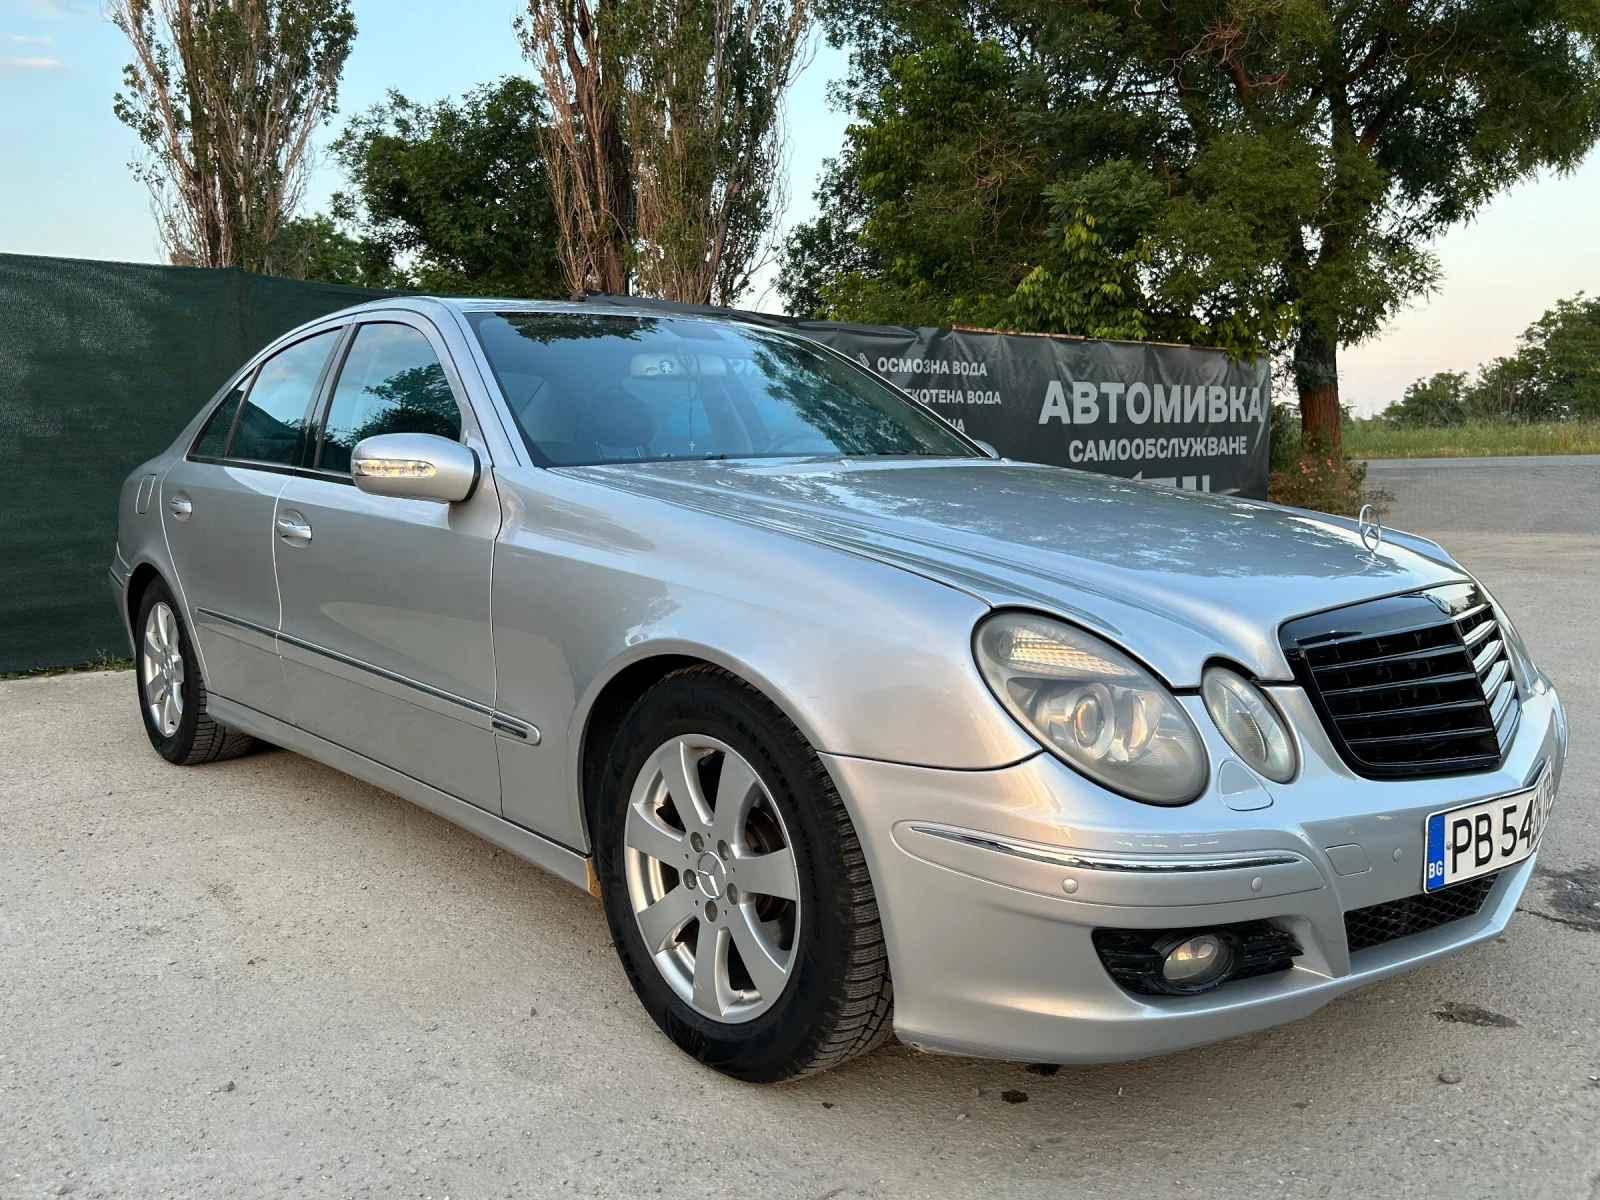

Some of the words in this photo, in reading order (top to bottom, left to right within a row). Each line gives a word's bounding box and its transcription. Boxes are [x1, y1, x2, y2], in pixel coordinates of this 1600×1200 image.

[877, 356, 950, 374] ОСМОЗНА
[952, 360, 988, 376] ВОДА
[967, 390, 1001, 404] ВОДА
[1038, 380, 1263, 424] АВТОМИВКА
[1069, 436, 1247, 463] САМООБСЛУЖВАНЕ
[1451, 812, 1494, 874] PB
[1428, 861, 1443, 879] BG
